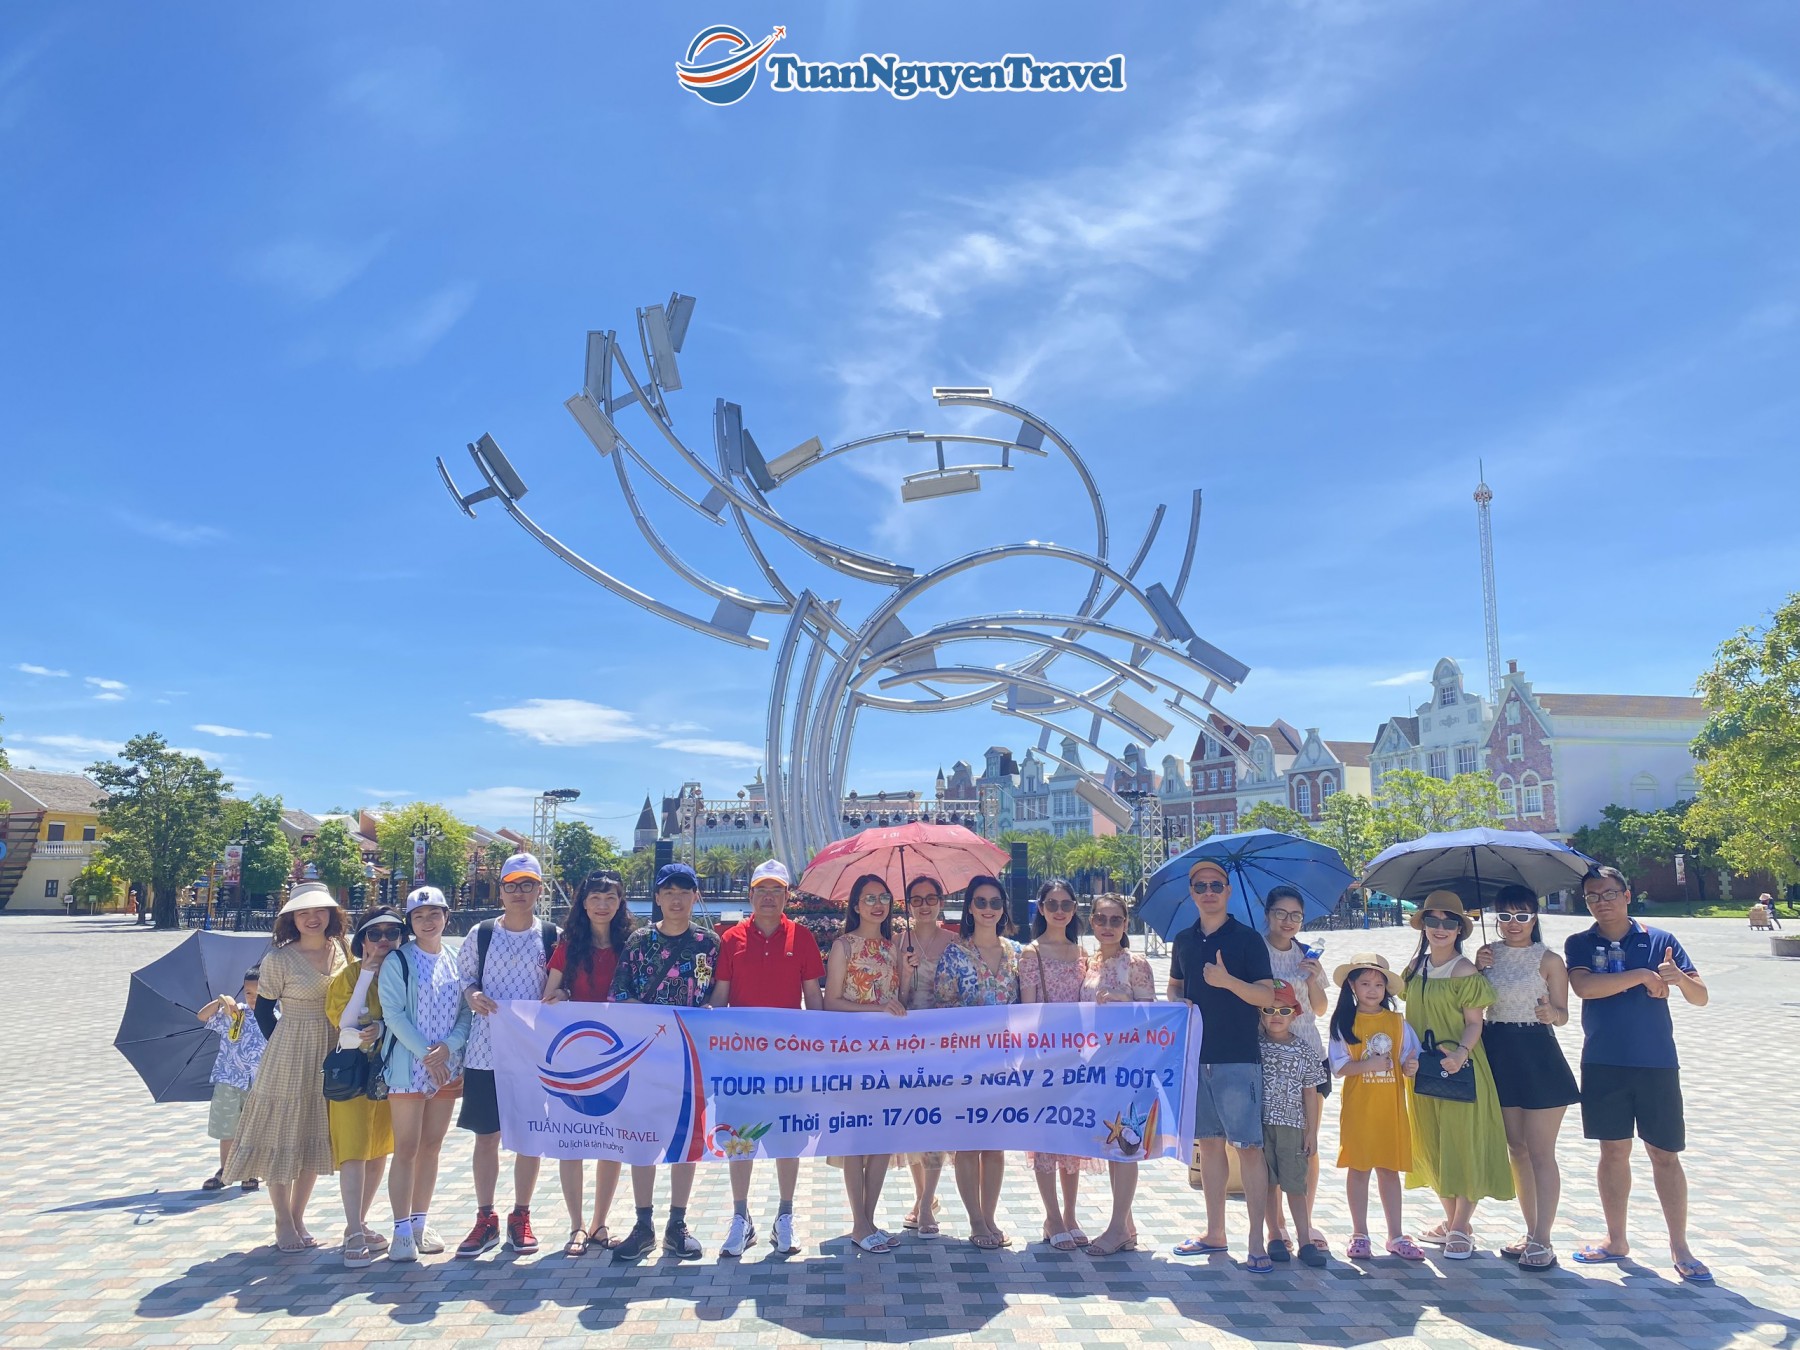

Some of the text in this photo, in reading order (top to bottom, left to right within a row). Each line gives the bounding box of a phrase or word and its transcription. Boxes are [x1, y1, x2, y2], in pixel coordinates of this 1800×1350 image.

[708, 1031, 769, 1052] PHÒNG
[774, 1033, 825, 1052] CÔNG
[829, 1034, 863, 1053] TÁC
[868, 1034, 891, 1051] XÃ
[896, 1033, 925, 1054] HỘI
[940, 1032, 981, 1053] BỆNH
[986, 1029, 1023, 1054] VIỆN
[1027, 1031, 1056, 1054] ĐẠI
[1061, 1031, 1099, 1053] HỌC
[1103, 1032, 1114, 1046] Y
[1118, 1027, 1141, 1045] HÀ
[1146, 1025, 1176, 1051] NỘI
[710, 1076, 766, 1097] TOUR
[774, 1075, 804, 1095] DU
[811, 1073, 853, 1095] LỊCH
[860, 1069, 891, 1091] ĐÀ
[960, 1074, 973, 1086] 3
[980, 1066, 1035, 1088] NGÀY
[1041, 1069, 1055, 1088] 2
[1062, 1064, 1107, 1086] ĐÊM
[1114, 1065, 1157, 1094] ĐỢT
[1161, 1068, 1175, 1088] 2
[527, 1117, 561, 1134] TUẤN
[615, 1128, 660, 1143] TRAVEL
[778, 1111, 820, 1133] Thời
[828, 1111, 874, 1134] gian:
[882, 1106, 943, 1127] 17/06
[558, 1139, 569, 1149] Du
